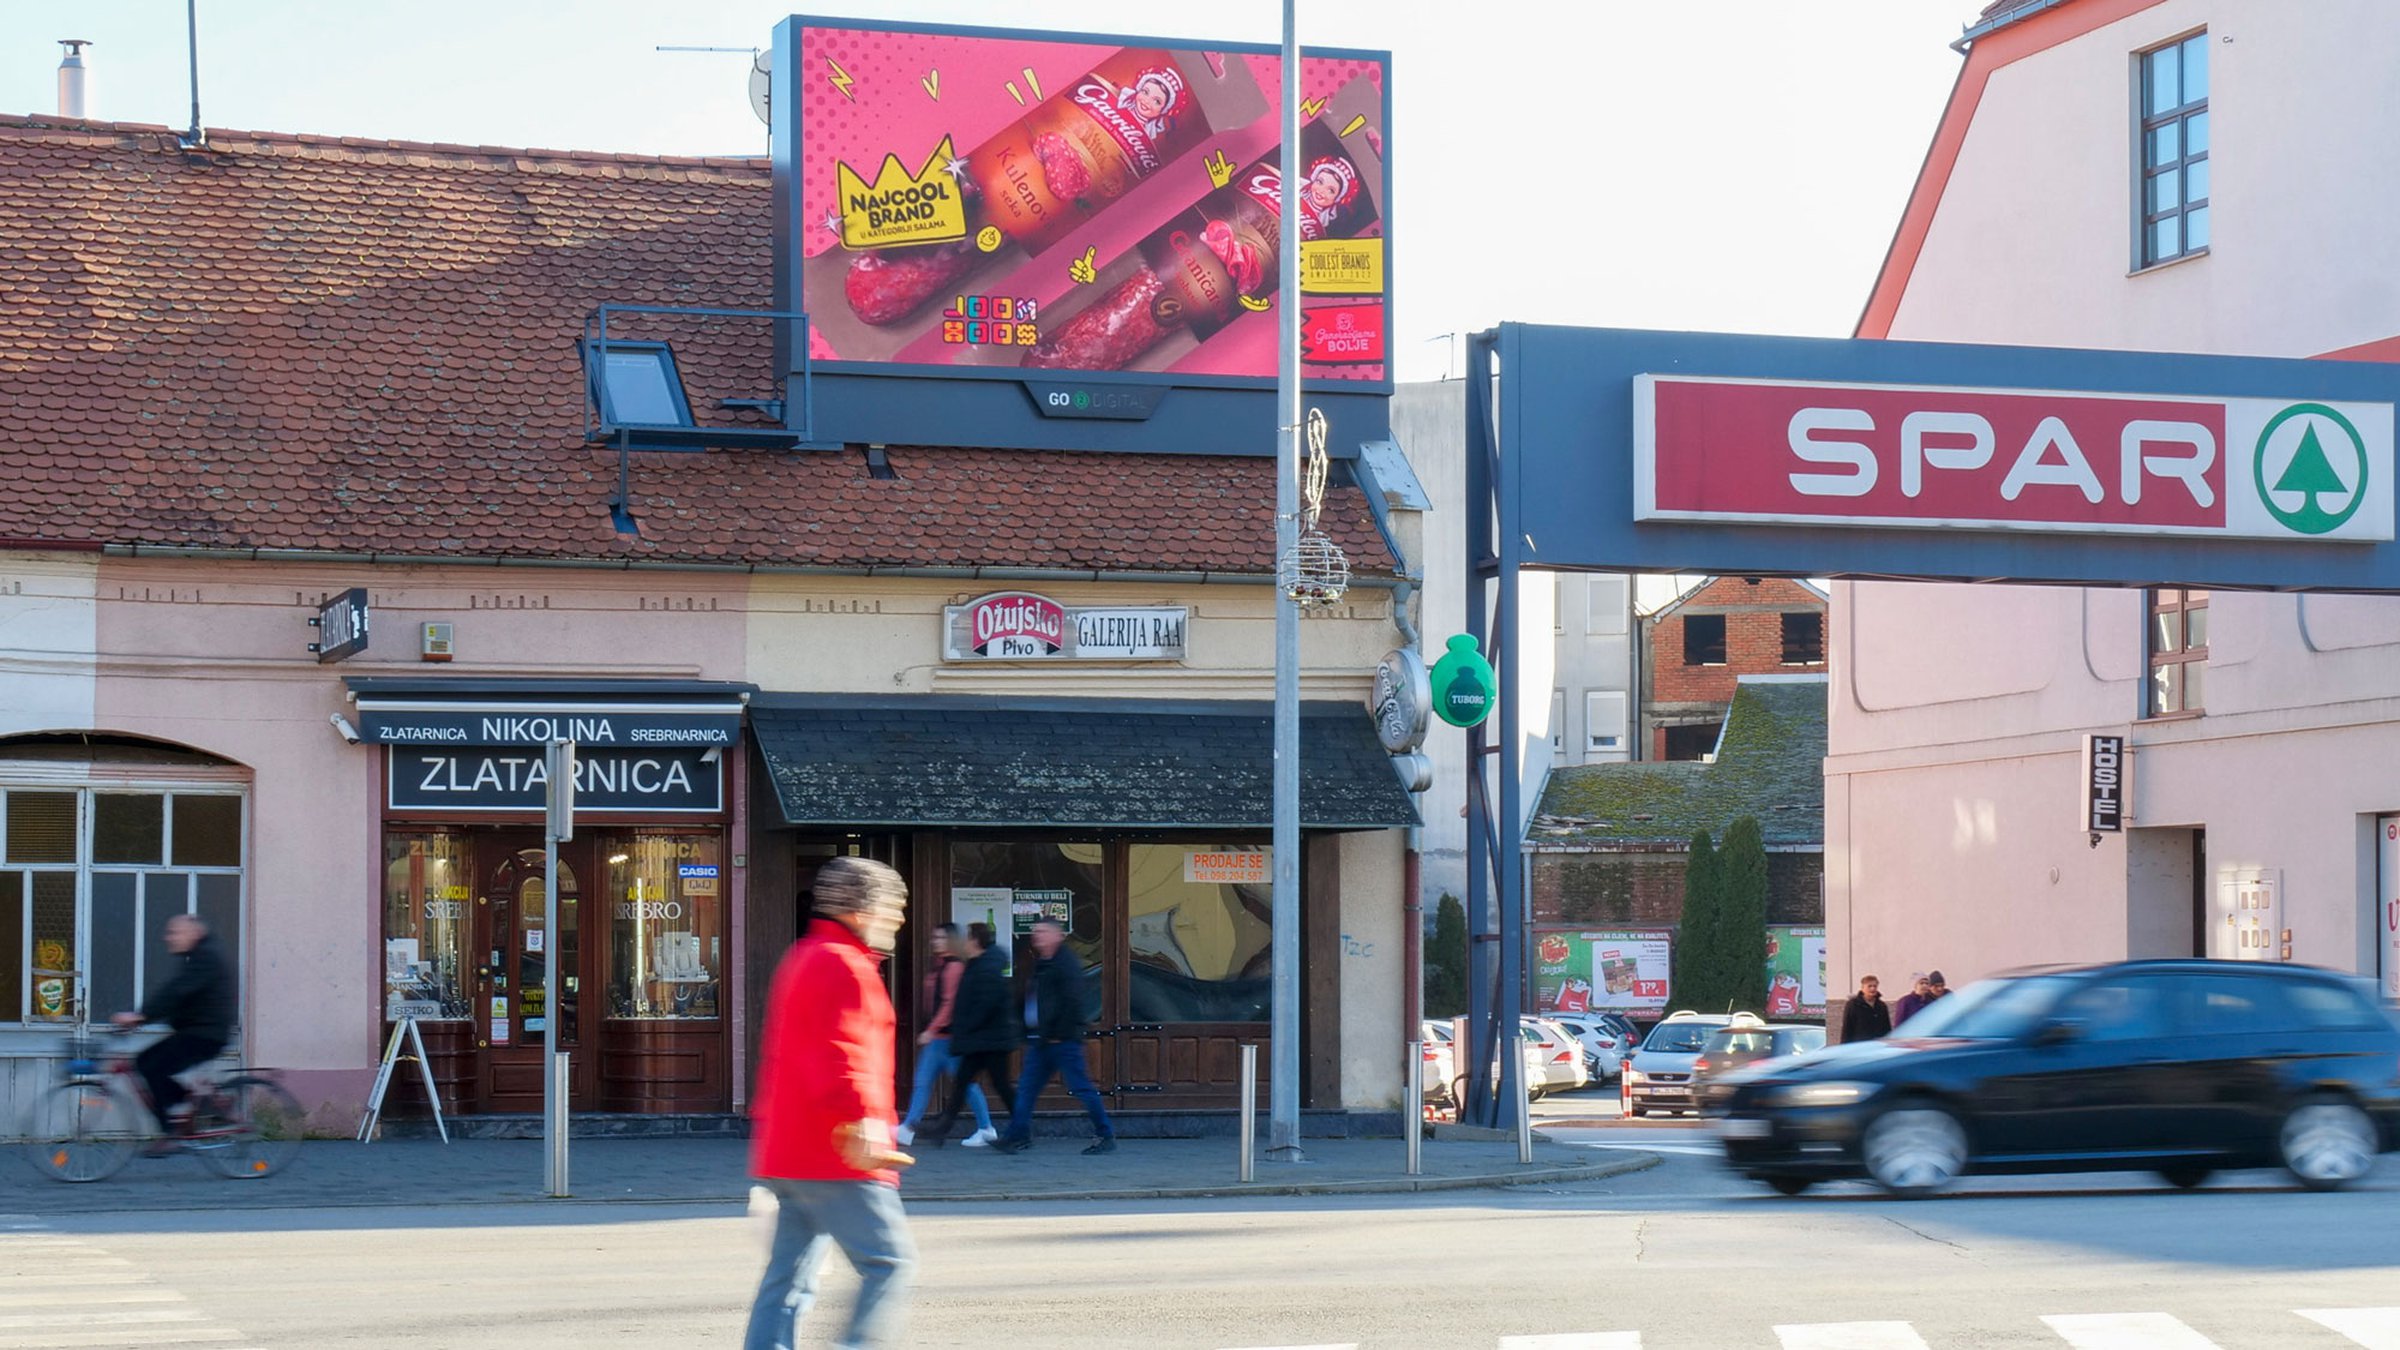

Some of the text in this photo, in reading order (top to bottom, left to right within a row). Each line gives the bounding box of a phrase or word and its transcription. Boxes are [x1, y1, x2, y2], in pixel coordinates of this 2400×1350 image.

[850, 182, 950, 213] NAJCOOL
[868, 202, 935, 229] BRAND
[1309, 253, 1371, 270] COOLEST BRANDS
[1328, 339, 1369, 352] BOLJE
[1049, 392, 1070, 406] GO
[1787, 407, 2216, 508] SPAR
[977, 598, 1060, 640] Ožujsko
[1078, 616, 1182, 655] GALERIJA RAA
[1002, 640, 1034, 656] Pivo
[380, 718, 728, 742] ZLATARNICA NIKOLINA SREBRNARNICA
[2093, 738, 2118, 830] HOSTEL
[1193, 854, 1264, 868] PRODAJE SE
[679, 868, 717, 877] CASIO
[1015, 892, 1043, 900] TURNIR
[394, 1006, 434, 1015] SEIKO
